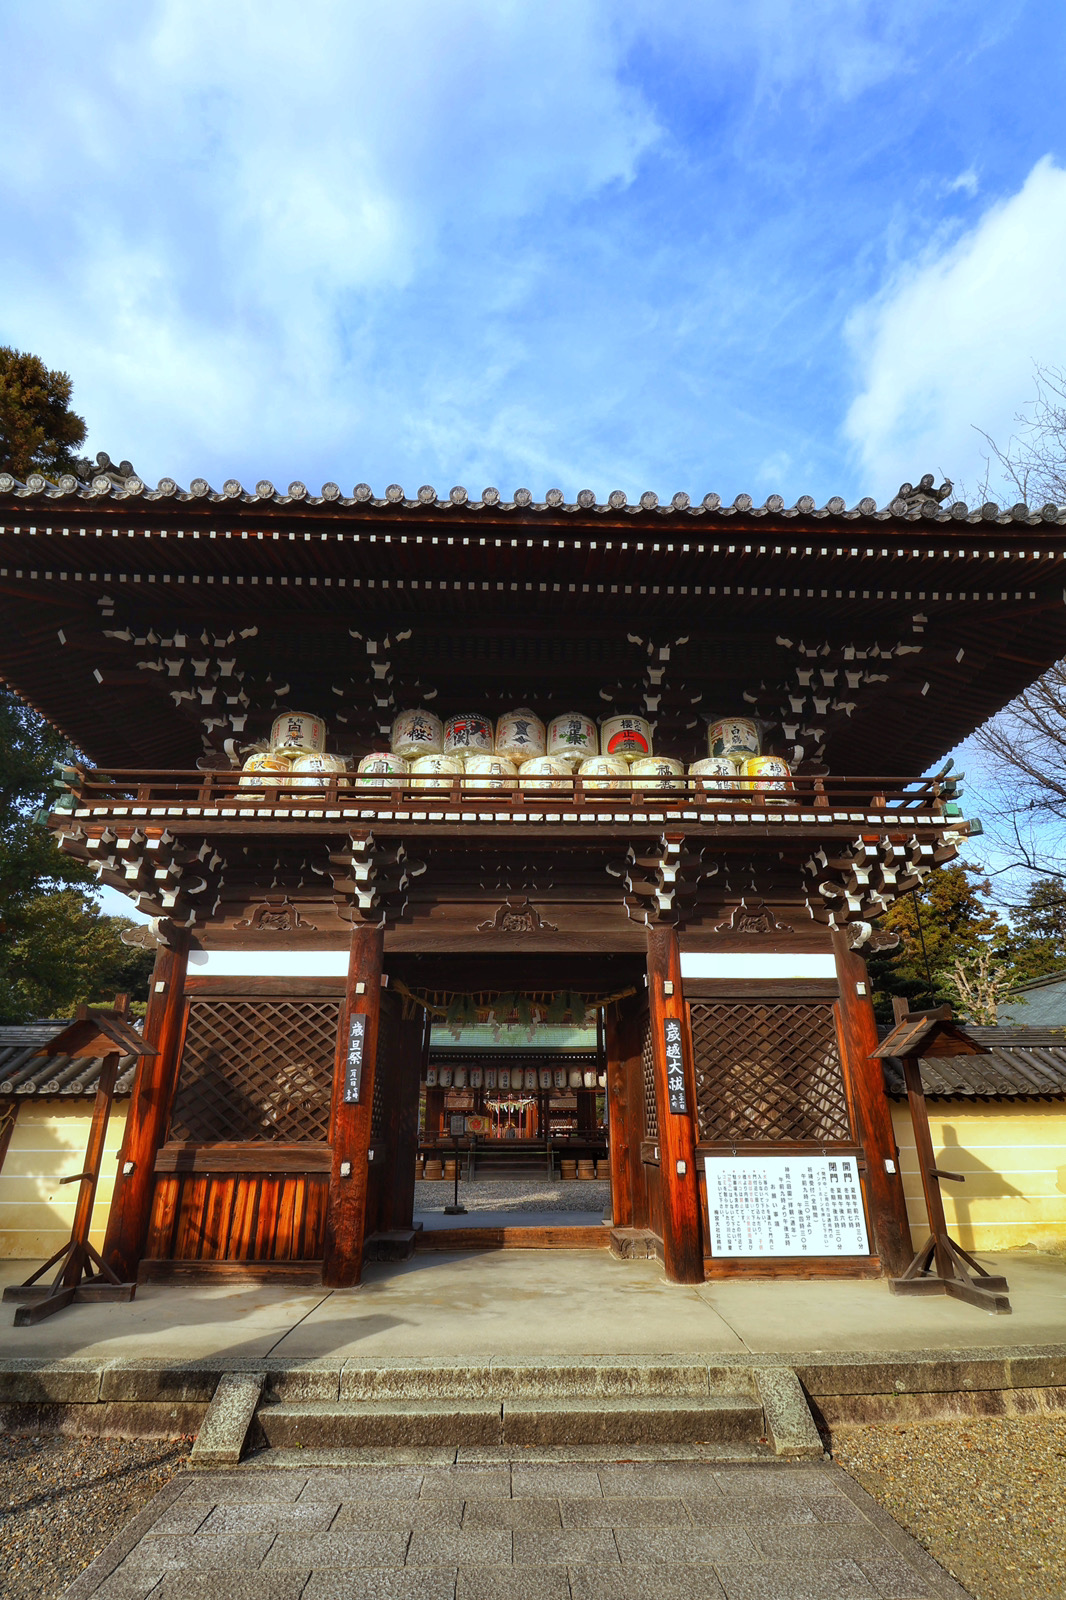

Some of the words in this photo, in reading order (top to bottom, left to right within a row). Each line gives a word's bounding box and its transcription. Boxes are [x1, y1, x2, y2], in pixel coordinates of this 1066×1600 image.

[348, 1022, 364, 1065] 歳旦祭
[350, 1068, 358, 1087] 一月一日
[828, 1162, 838, 1182] 閉門
[841, 1161, 852, 1182] 開門
